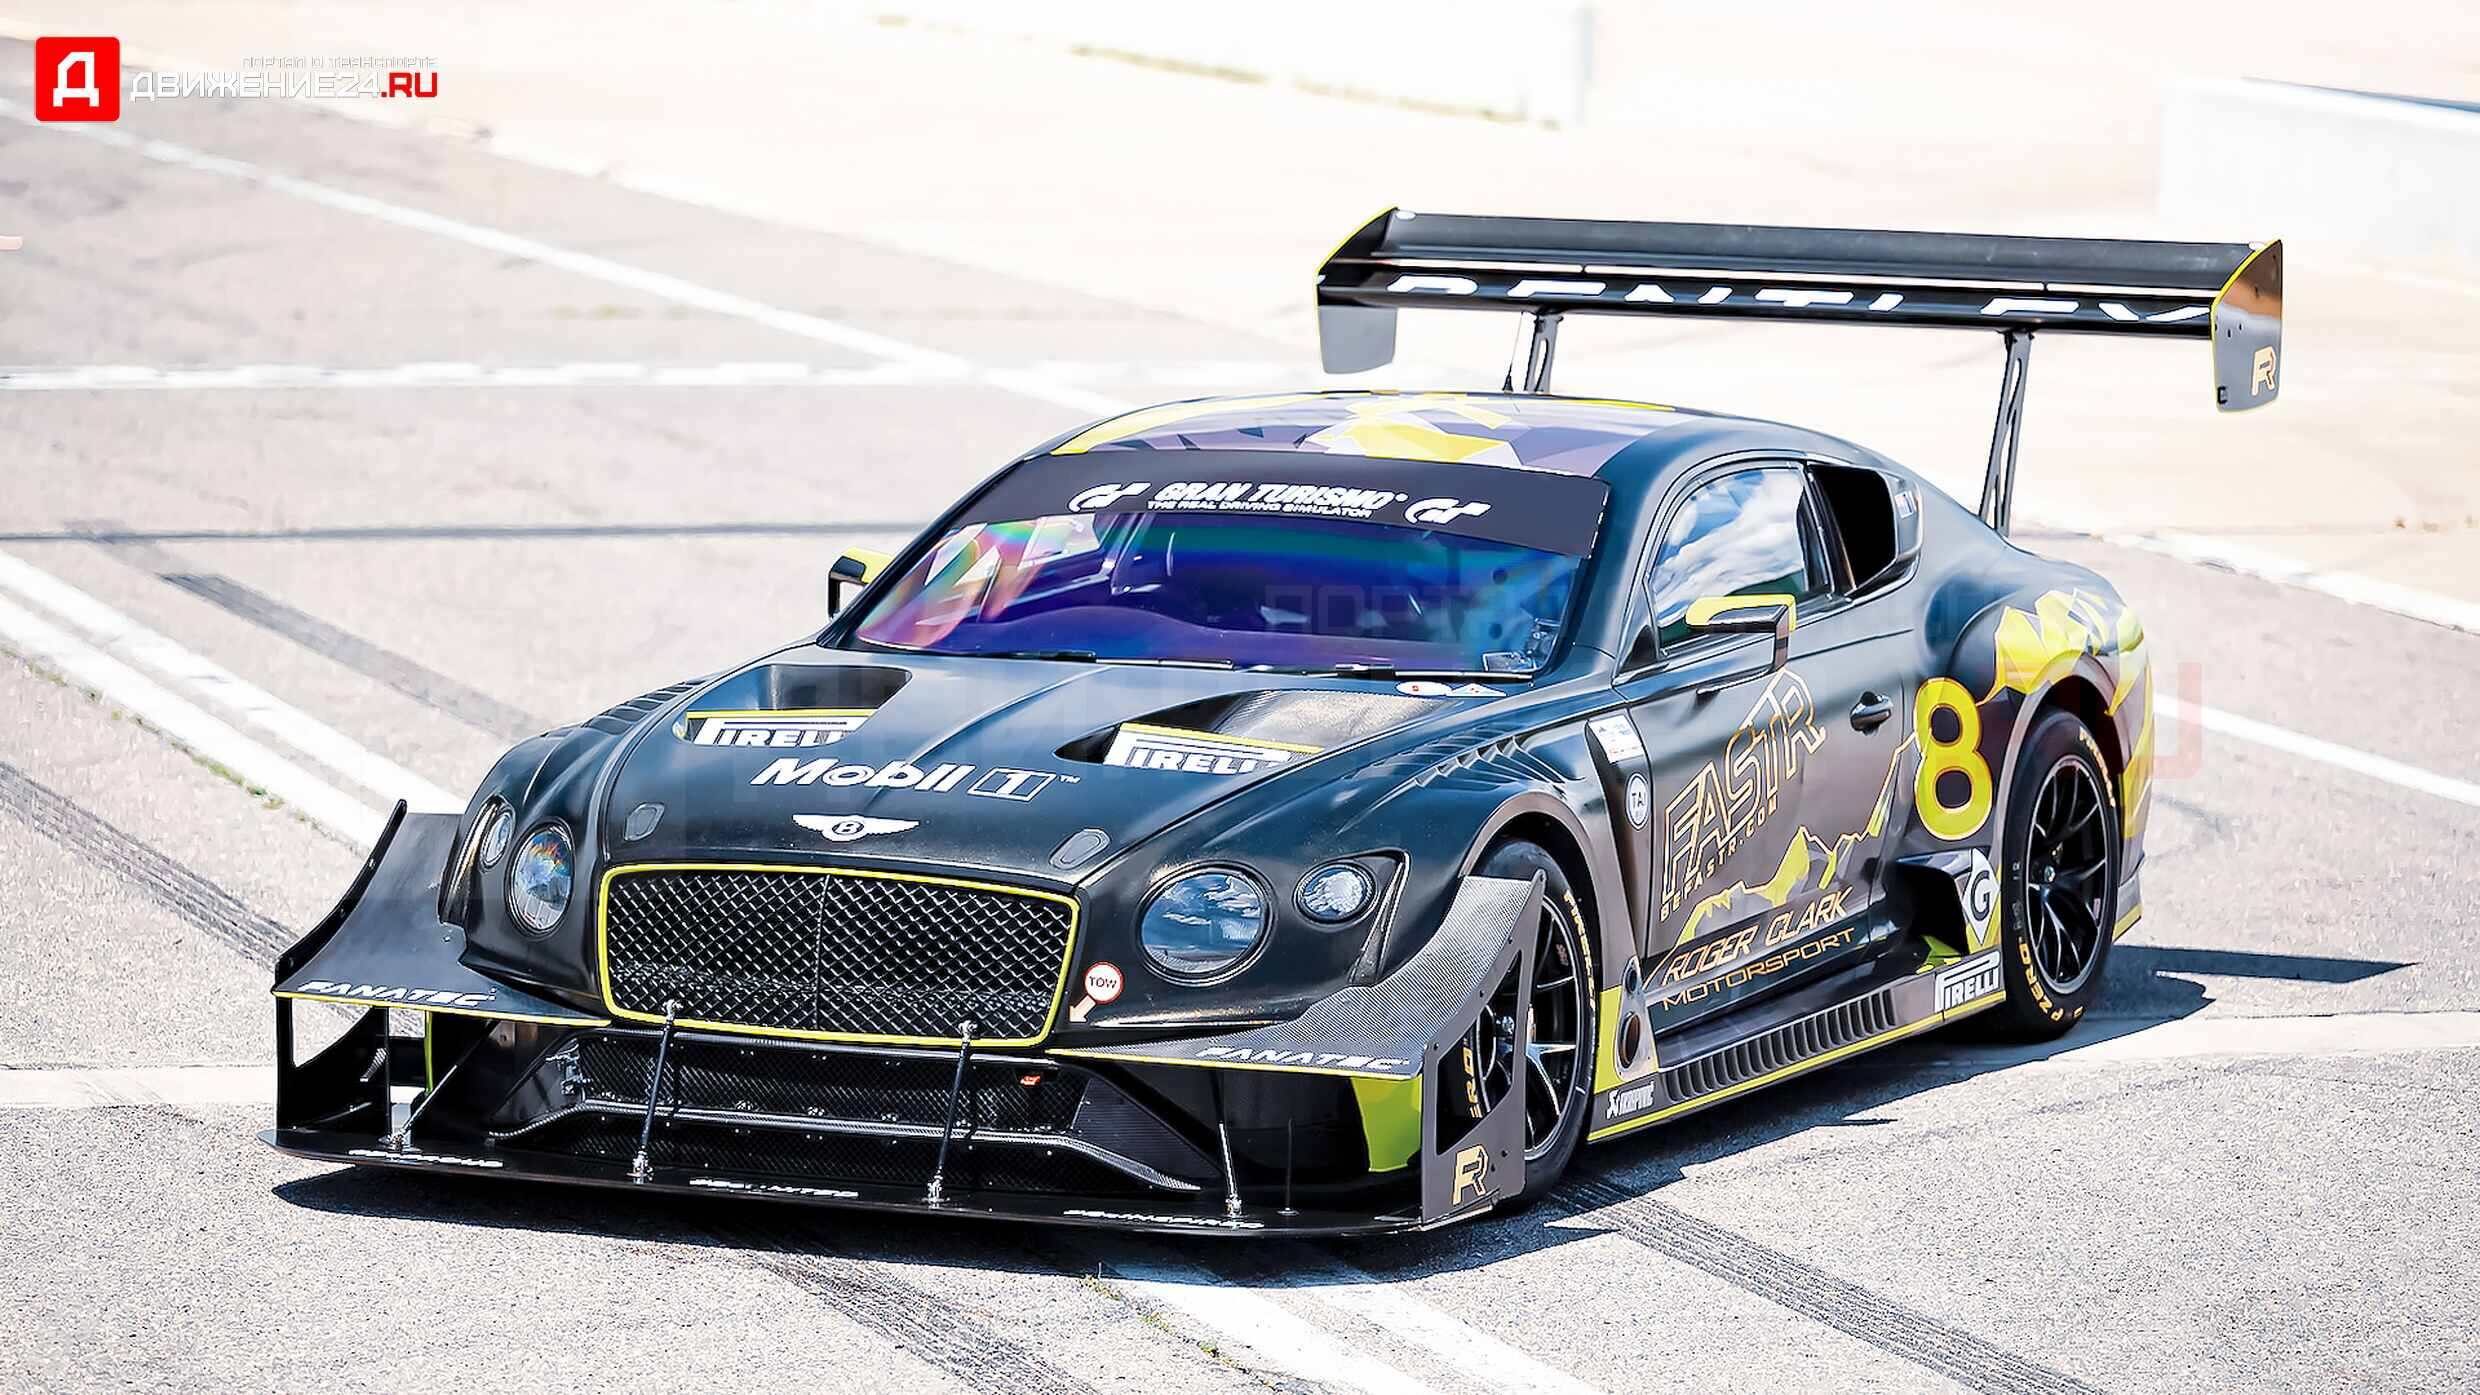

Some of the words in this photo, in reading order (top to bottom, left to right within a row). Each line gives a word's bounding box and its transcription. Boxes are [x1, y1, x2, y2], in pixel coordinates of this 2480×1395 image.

[1154, 482, 1253, 502] GRAN
[1147, 500, 1178, 510] THE
[1178, 501, 1218, 511] REAL
[1218, 501, 1282, 512] DRIVING
[1282, 503, 1374, 519] SIMULATOR
[1912, 675, 1994, 842] 8
[749, 757, 976, 793] Mobil
[1661, 924, 1761, 987] ROGER
[1765, 886, 1854, 947] CLARK
[1088, 976, 1118, 990] TOW
[1662, 927, 1856, 1011] MOTORSPORT
[1934, 949, 2000, 1014] PIRELLI
[297, 979, 492, 1008] FANATEC
[1195, 1046, 1400, 1072] FANATEC
